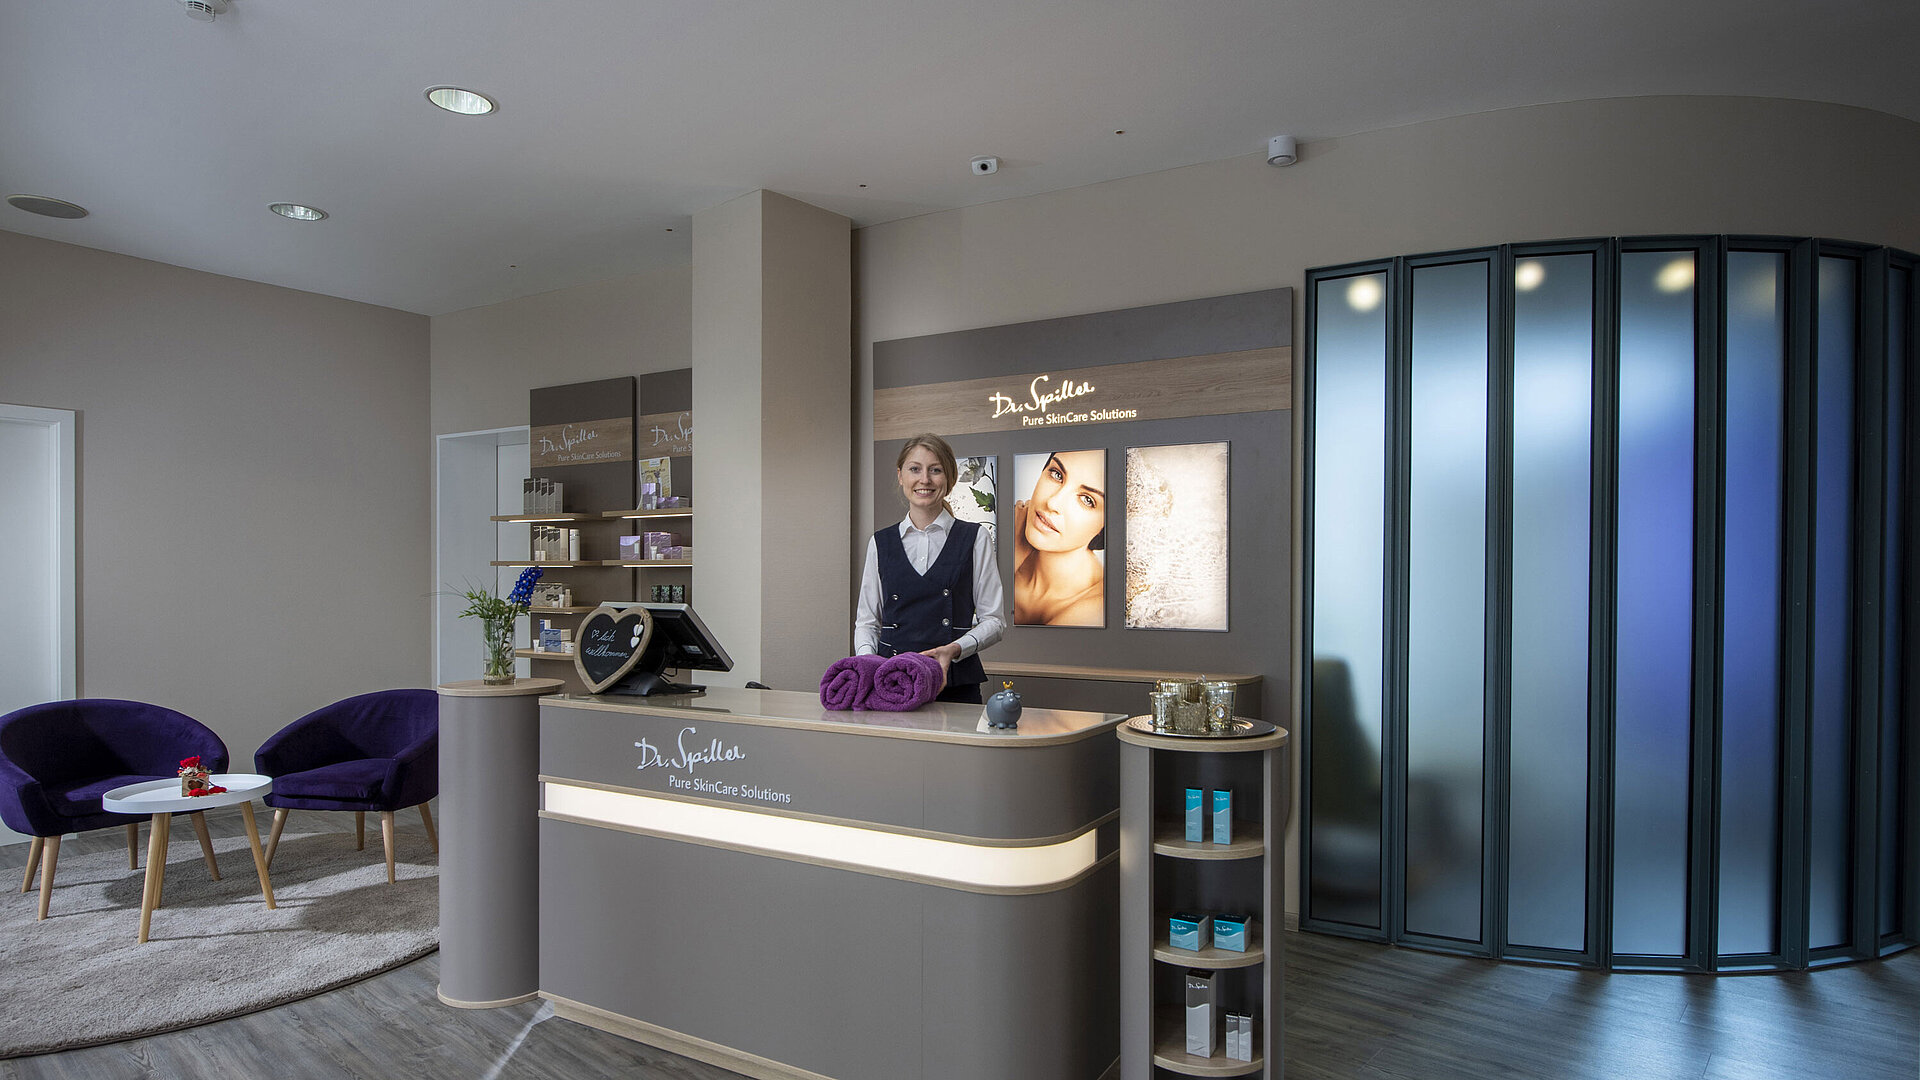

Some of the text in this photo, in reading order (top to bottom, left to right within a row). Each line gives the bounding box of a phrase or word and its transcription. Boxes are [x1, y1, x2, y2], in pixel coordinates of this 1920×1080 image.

[988, 375, 1095, 419] Dr. Spiller
[1022, 408, 1137, 426] Pure SkinCare Solutions
[539, 424, 598, 456] Dr. Spiller
[650, 425, 673, 447] Dr.
[672, 444, 687, 453] Pure
[557, 450, 622, 462] Pure SkinCare Solutions
[634, 727, 746, 774] Dr. Spiller
[669, 774, 792, 804] Pure SkinCare Solutions
